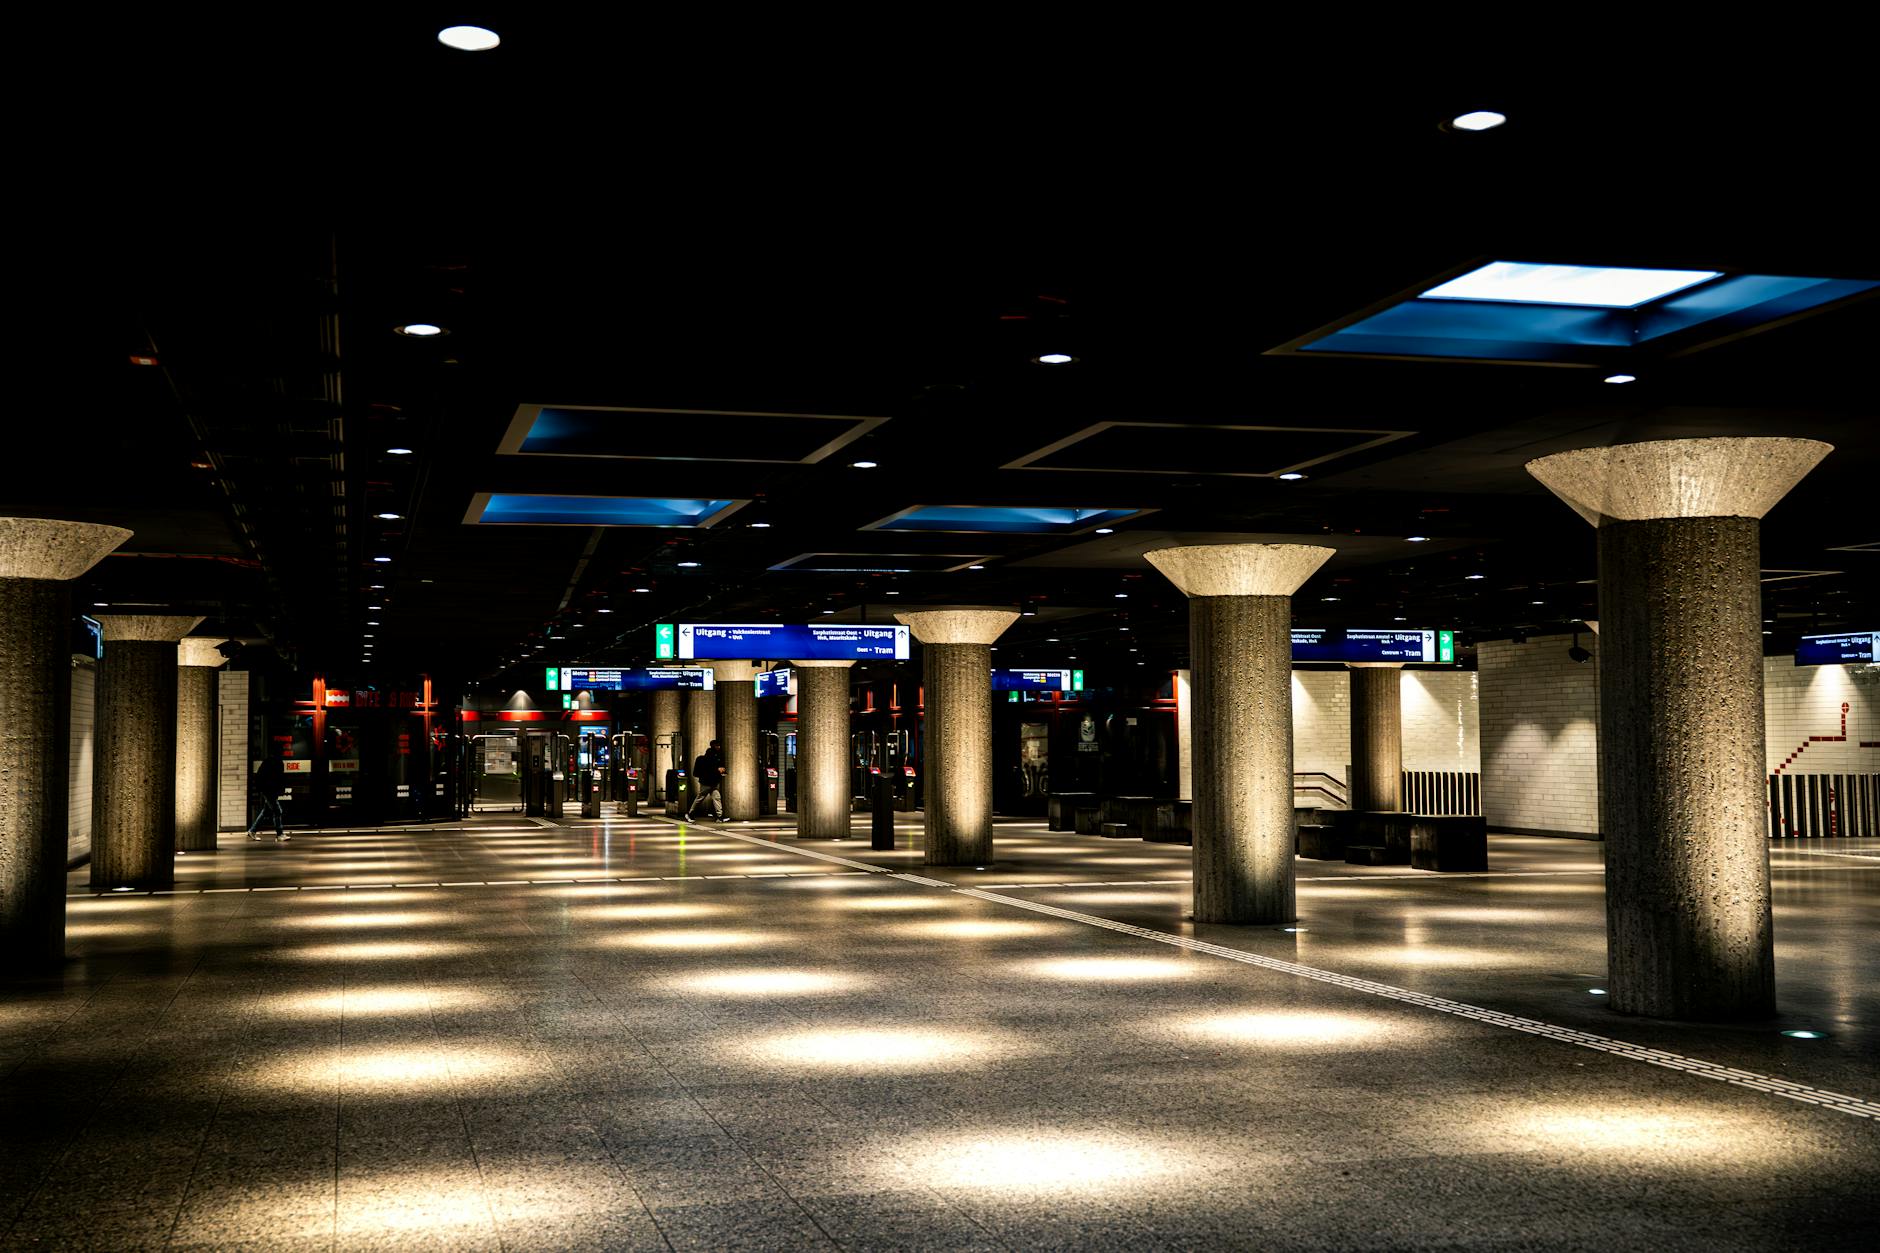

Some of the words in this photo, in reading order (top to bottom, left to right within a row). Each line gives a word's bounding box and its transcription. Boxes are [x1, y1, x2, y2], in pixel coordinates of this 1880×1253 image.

[696, 629, 726, 637] Uitgang
[864, 630, 893, 639] Uitgang
[1395, 634, 1420, 642] Uitgang
